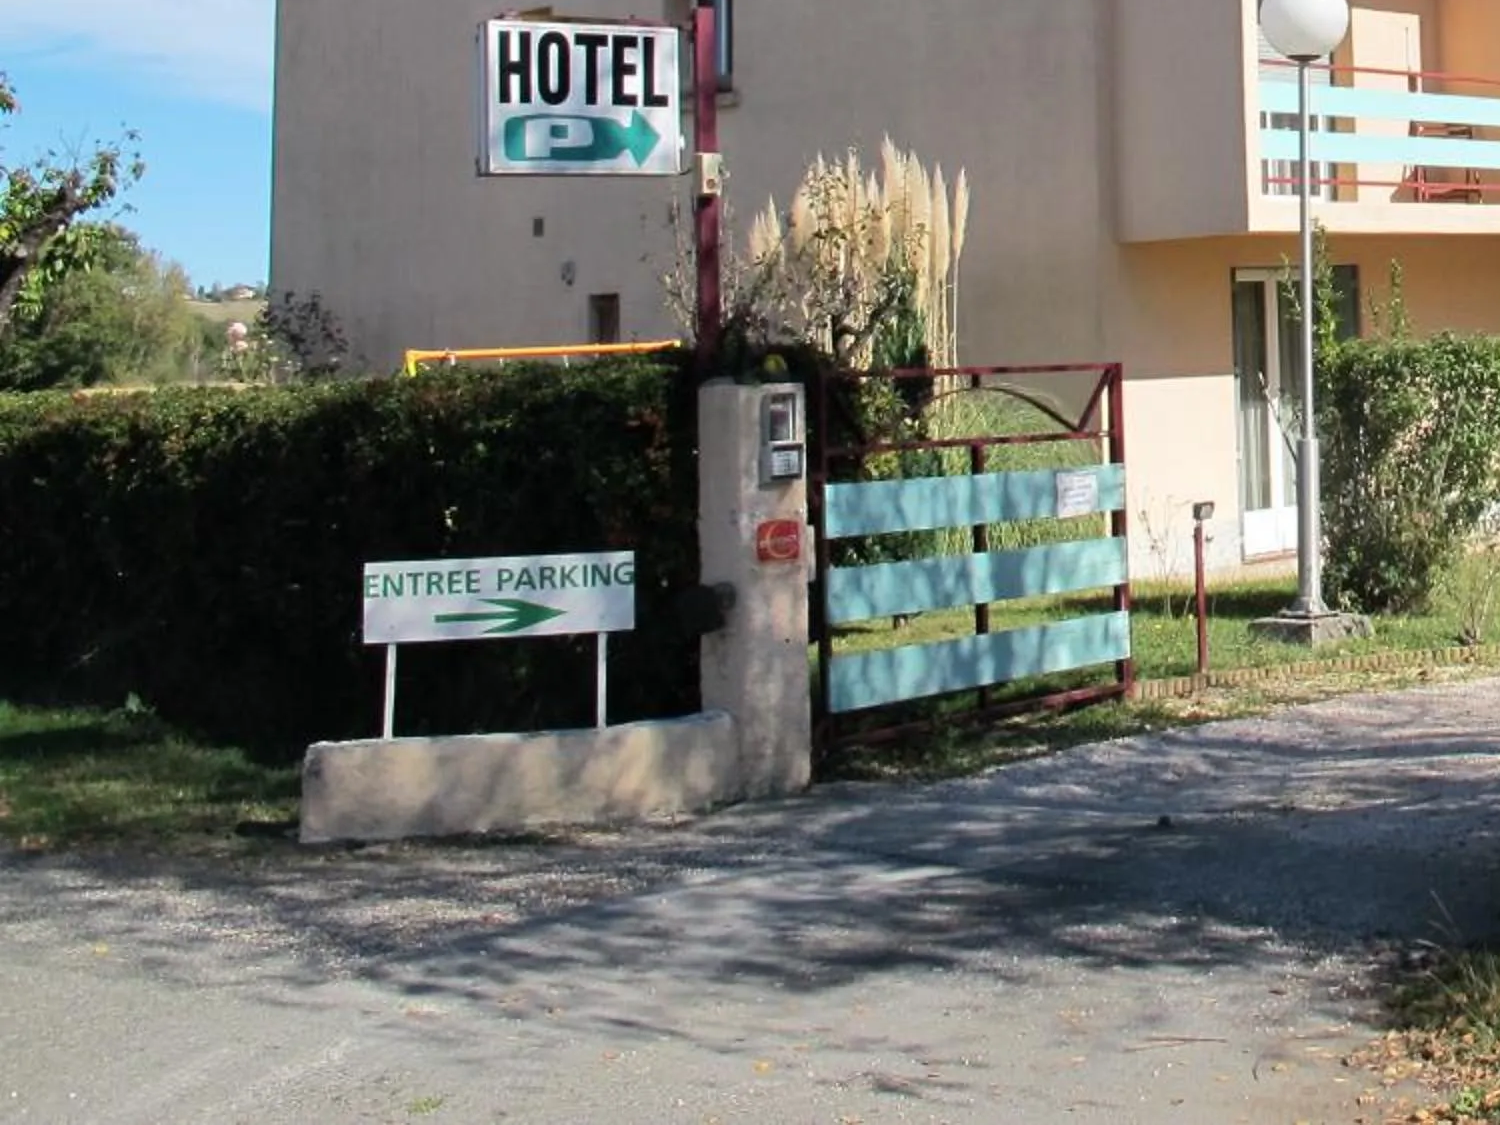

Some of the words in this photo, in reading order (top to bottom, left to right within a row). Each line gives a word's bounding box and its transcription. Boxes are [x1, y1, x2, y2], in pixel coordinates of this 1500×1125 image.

[498, 30, 669, 107] HOTEL
[525, 118, 594, 159] P
[364, 569, 481, 599] ENTREE
[496, 561, 635, 592] PARKING
